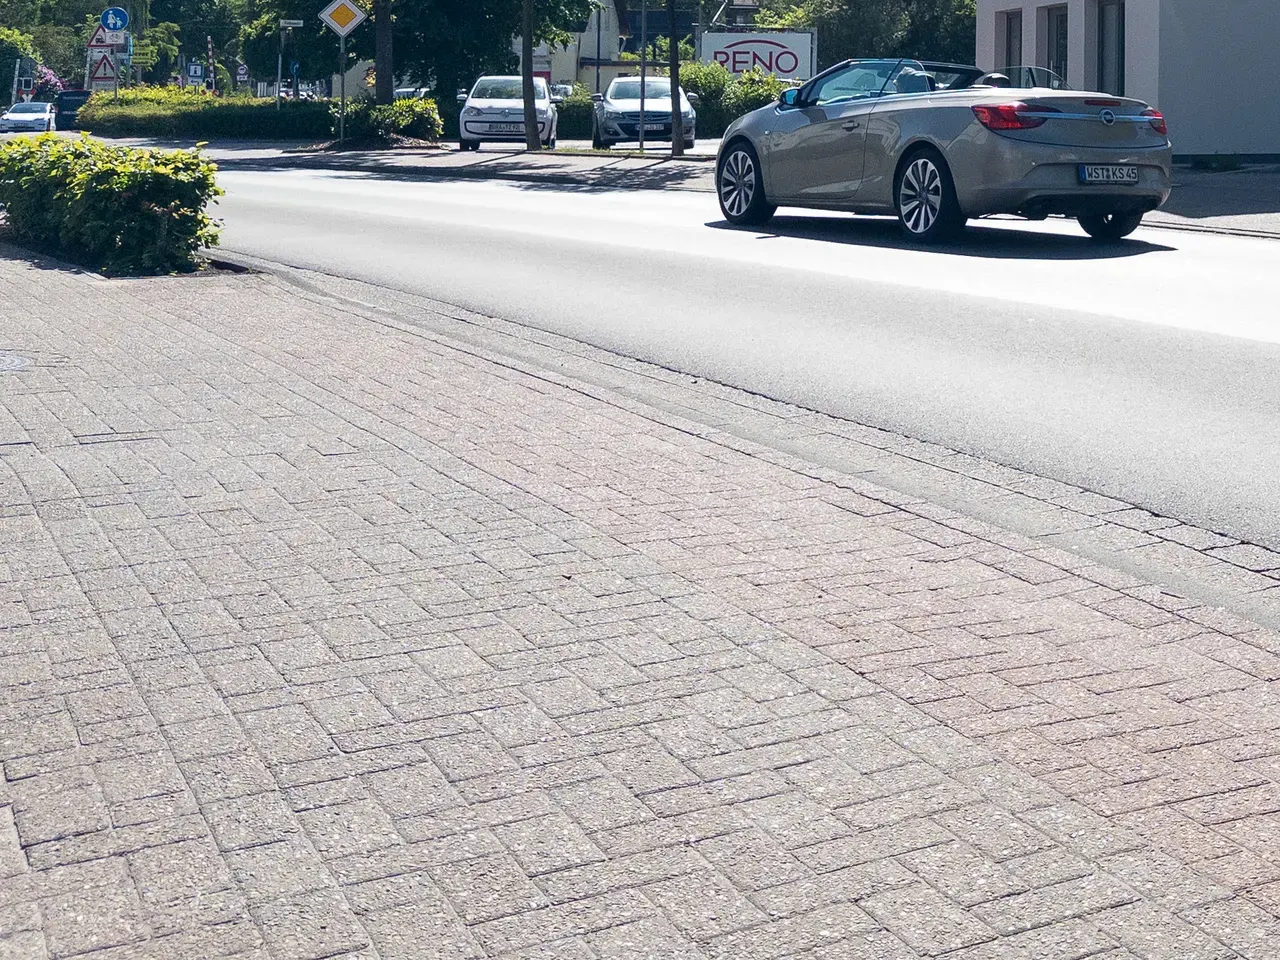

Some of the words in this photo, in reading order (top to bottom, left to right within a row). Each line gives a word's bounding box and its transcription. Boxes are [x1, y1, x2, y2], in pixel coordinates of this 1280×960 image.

[713, 51, 799, 74] RENO
[1086, 167, 1106, 179] WST
[1112, 168, 1125, 179] KS
